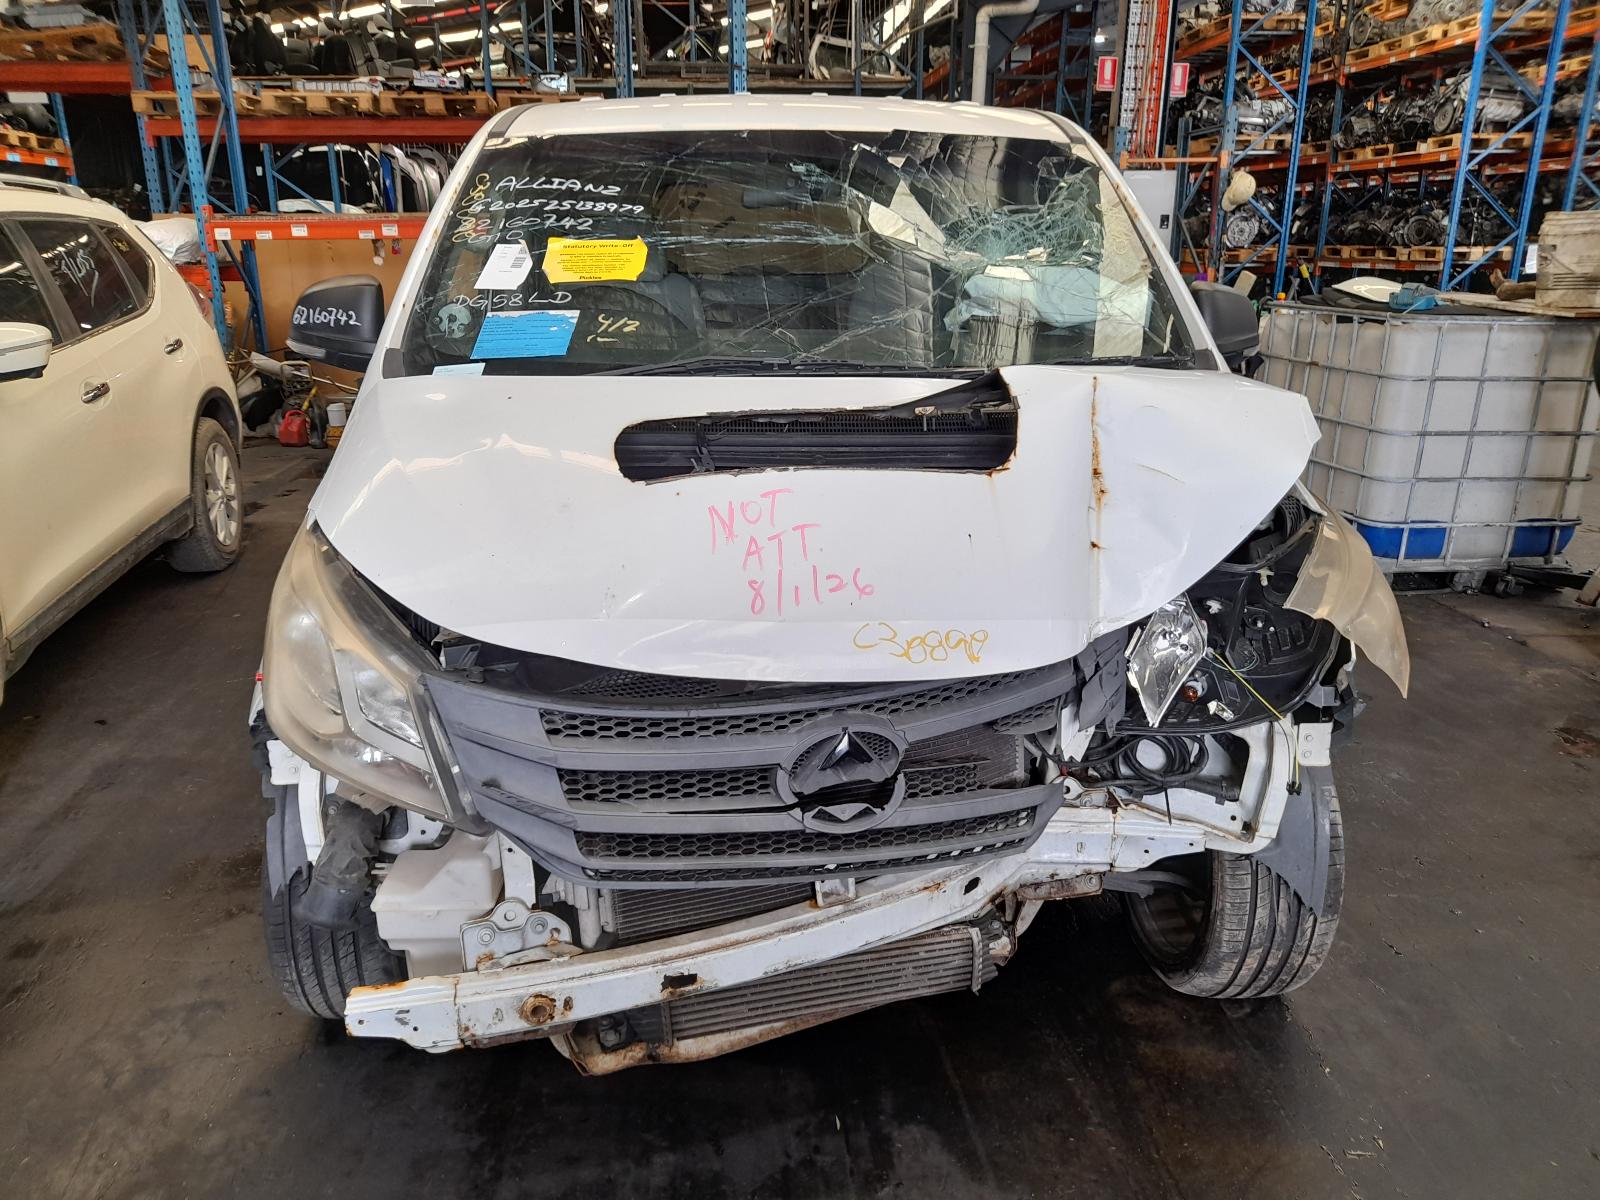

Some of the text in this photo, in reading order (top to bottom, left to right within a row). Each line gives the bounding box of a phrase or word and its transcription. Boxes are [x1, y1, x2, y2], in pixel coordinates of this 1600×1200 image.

[495, 175, 621, 196] ALLIANZ
[292, 305, 362, 327] 62160742
[708, 488, 792, 553] NOT
